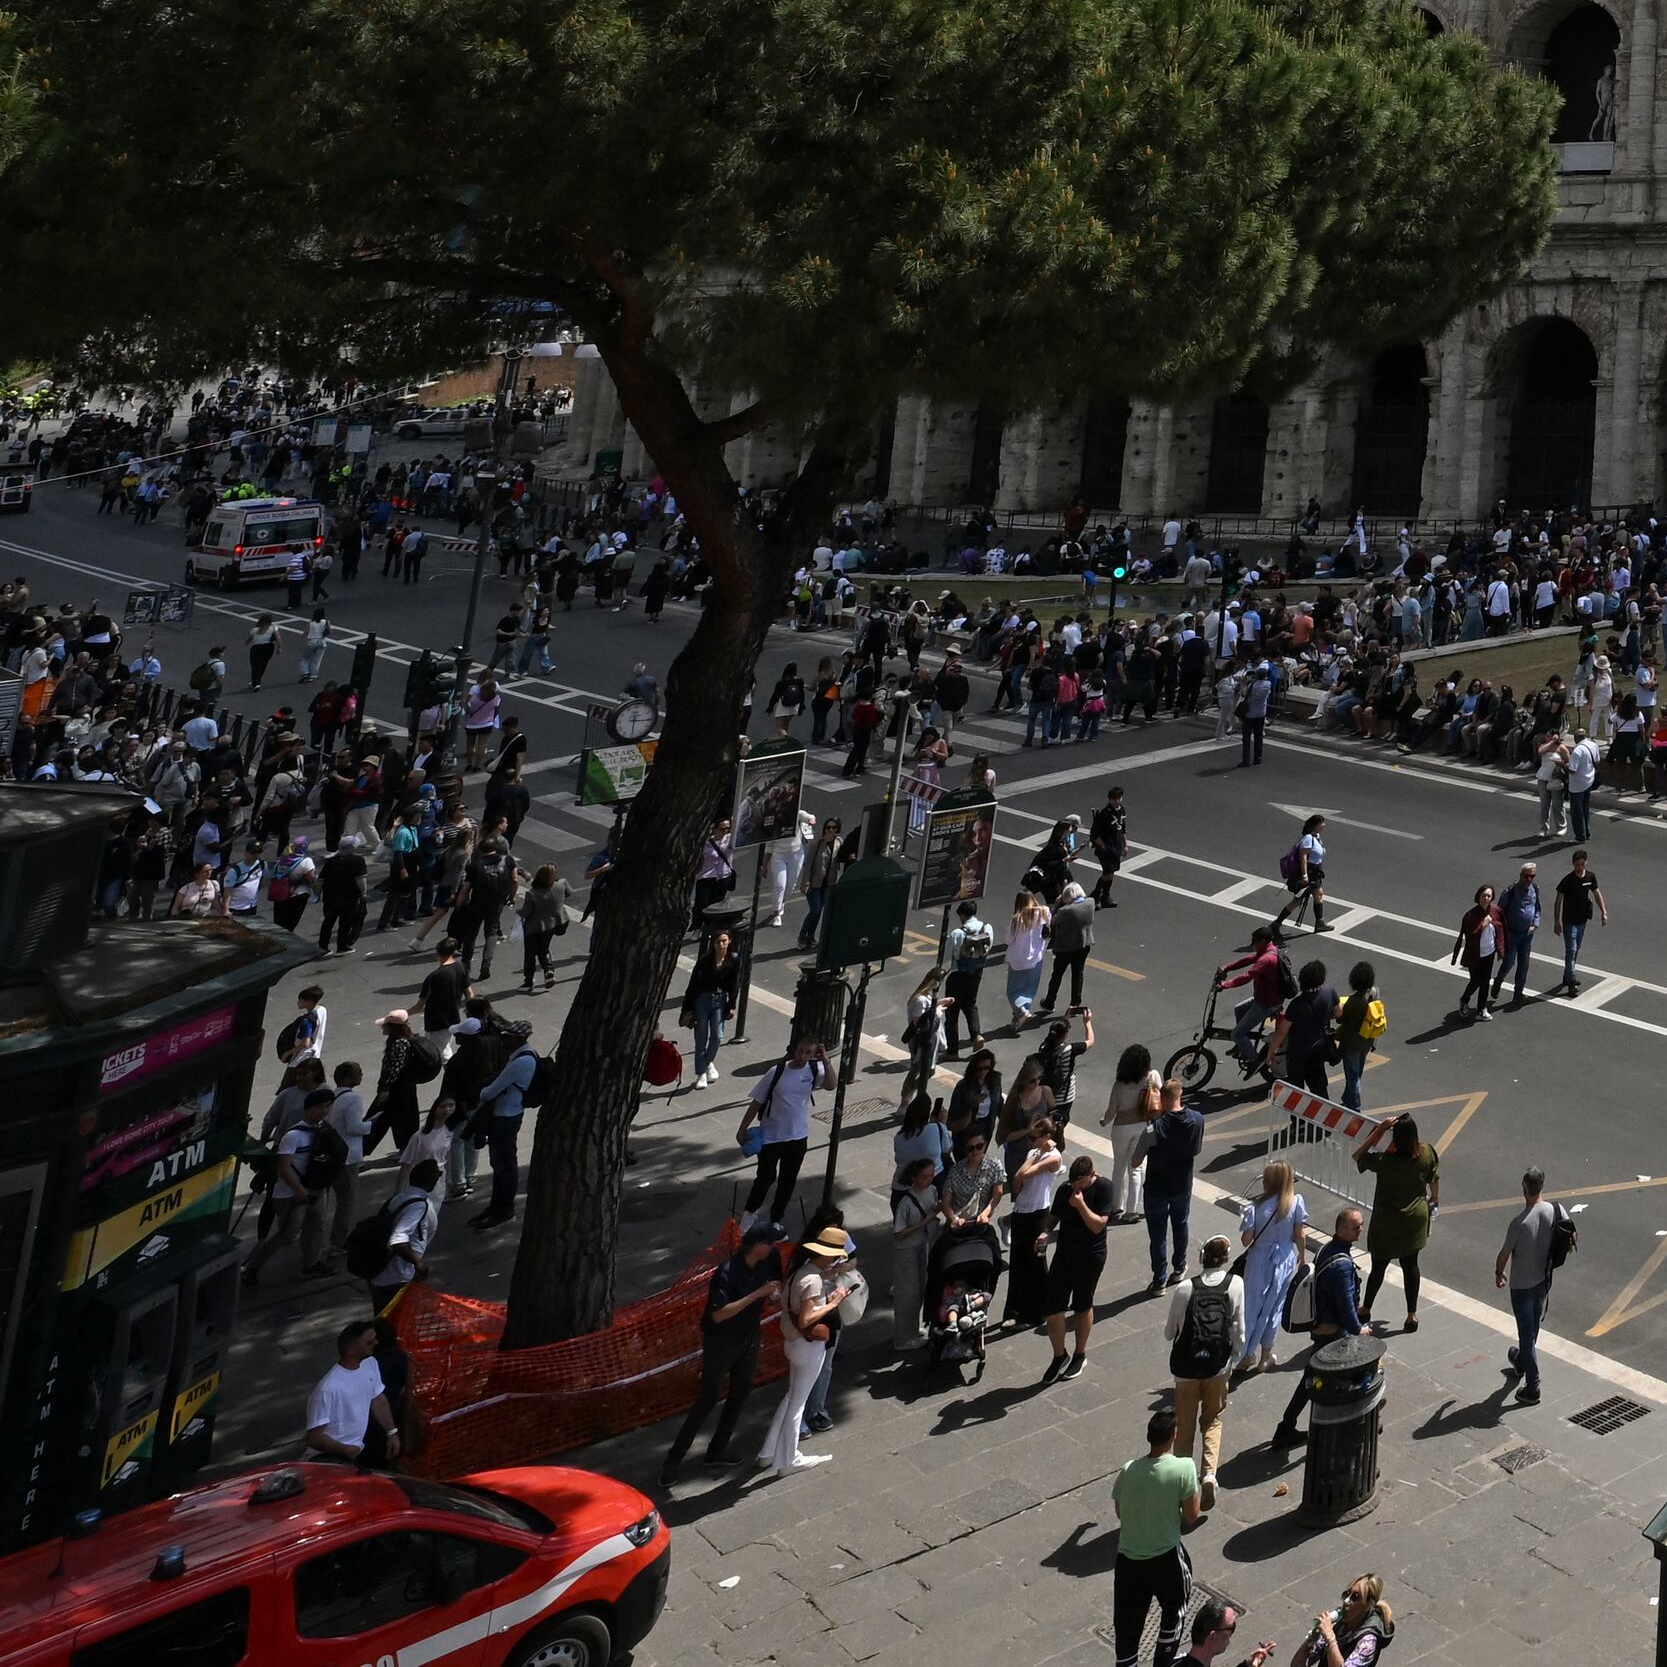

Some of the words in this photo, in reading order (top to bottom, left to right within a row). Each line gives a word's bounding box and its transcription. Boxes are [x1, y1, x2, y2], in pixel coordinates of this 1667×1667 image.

[108, 1065, 128, 1080] HERE
[107, 1136, 124, 1149] LOVE
[143, 1121, 157, 1134] CITY
[158, 1113, 175, 1128] TOUR
[147, 1140, 206, 1189] ATM
[138, 1188, 184, 1227] ATM
[40, 1355, 59, 1422] ATM
[184, 1378, 213, 1407] ATM
[117, 1420, 148, 1450] ATM
[21, 1441, 45, 1531] HERE
